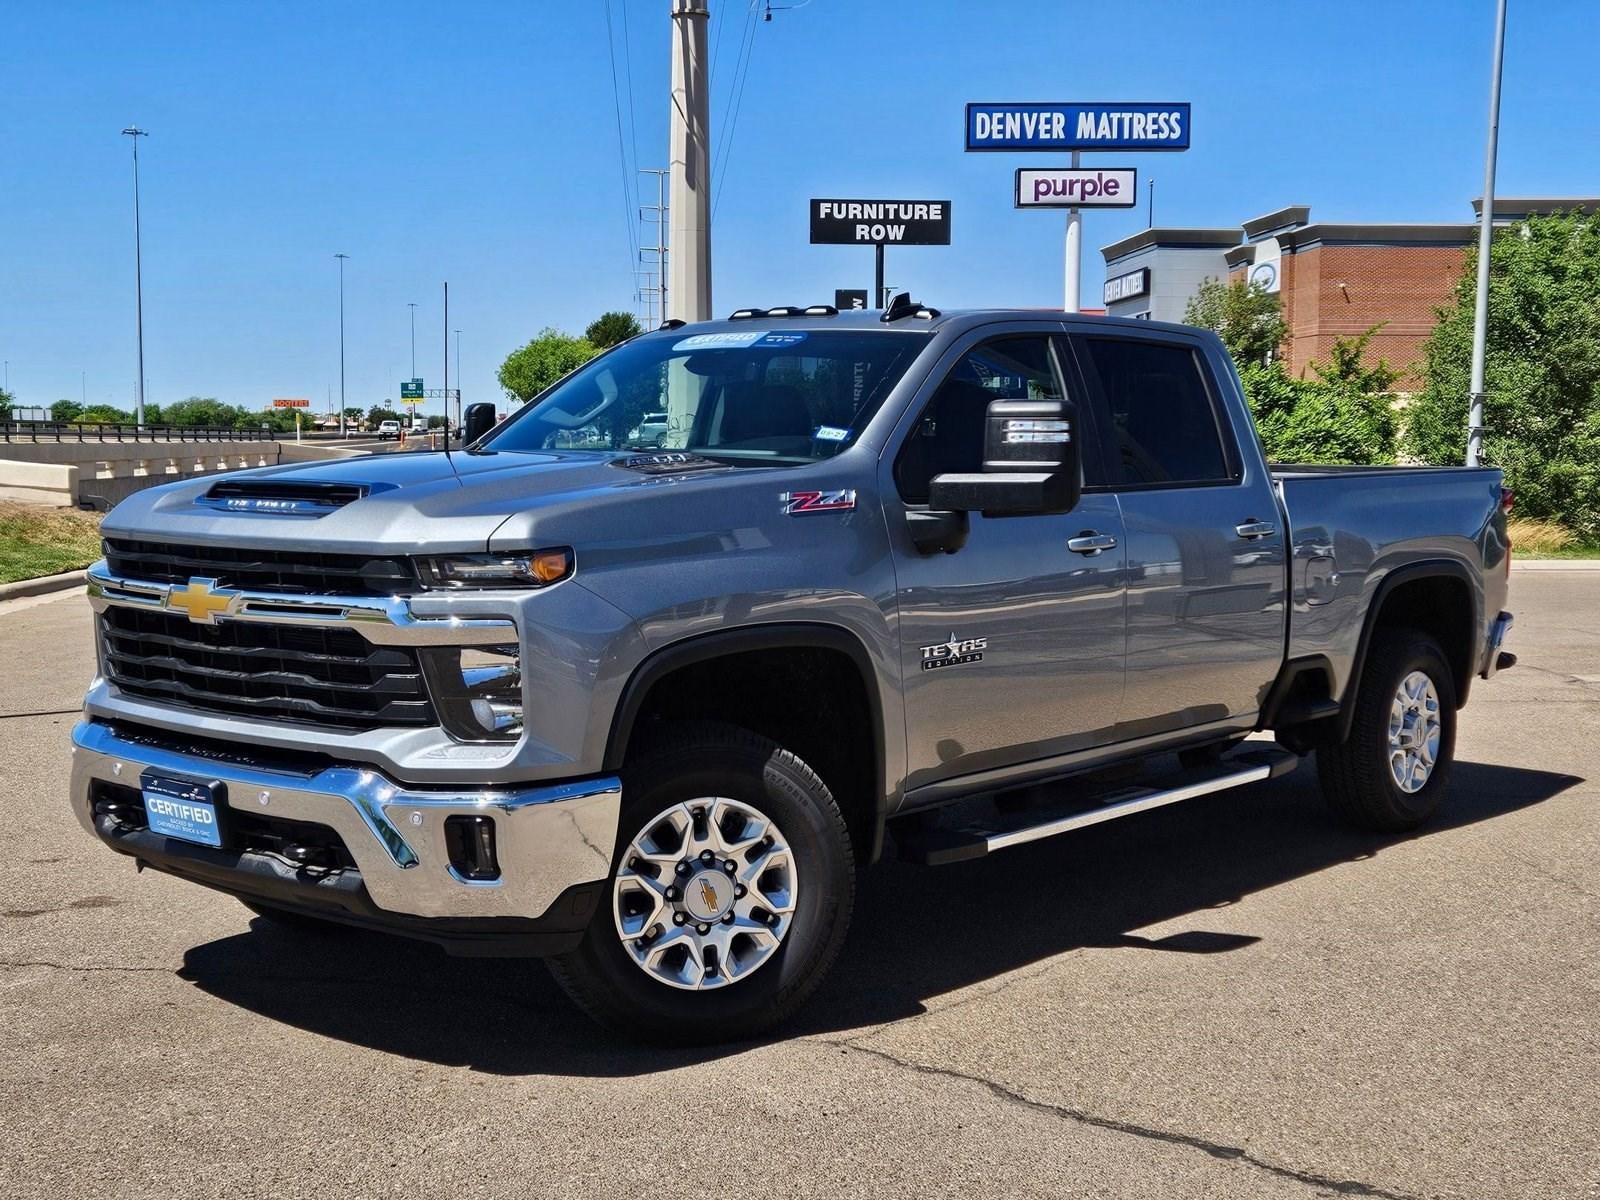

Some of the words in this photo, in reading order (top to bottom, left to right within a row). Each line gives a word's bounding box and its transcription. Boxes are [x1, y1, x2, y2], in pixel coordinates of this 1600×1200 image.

[976, 112, 1065, 140] DENVER
[1076, 111, 1182, 140] MATTRESS
[1034, 171, 1121, 201] purple
[819, 203, 942, 220] FURNITURE
[855, 224, 906, 241] ROW
[920, 633, 987, 659] TEXAS
[927, 654, 981, 669] EDITION
[149, 798, 213, 824] CERTIFIED
